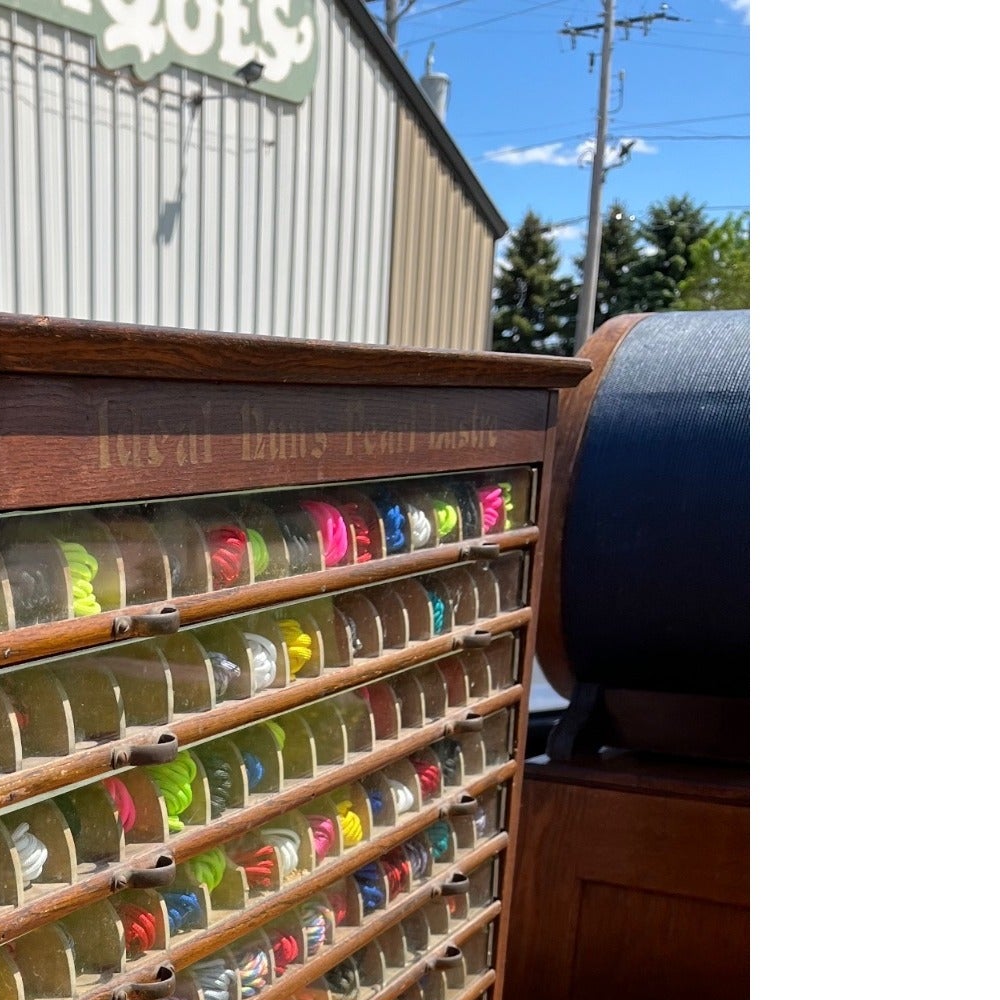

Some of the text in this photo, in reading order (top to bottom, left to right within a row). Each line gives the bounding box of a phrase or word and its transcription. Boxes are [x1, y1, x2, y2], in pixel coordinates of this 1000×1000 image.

[61, 0, 313, 82] QUES
[97, 399, 213, 469] Ideal
[344, 398, 416, 457] Pearl
